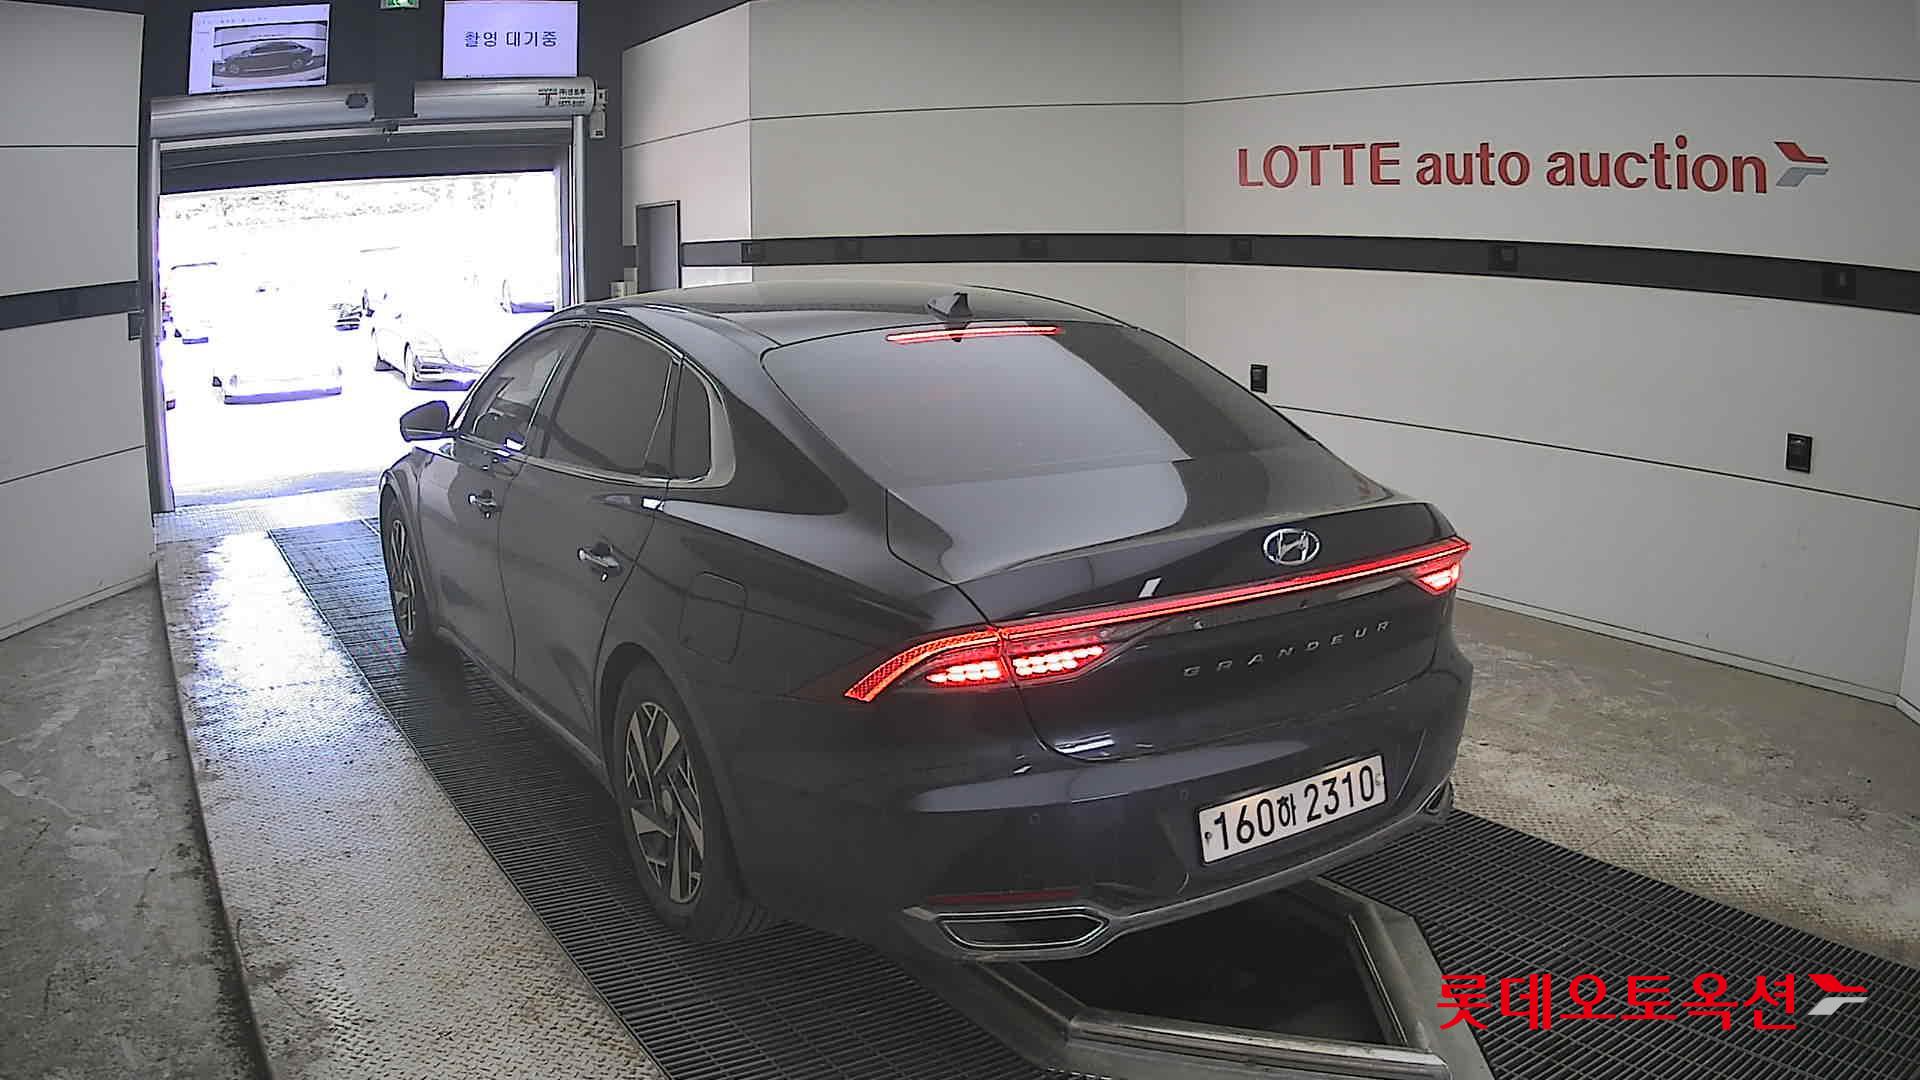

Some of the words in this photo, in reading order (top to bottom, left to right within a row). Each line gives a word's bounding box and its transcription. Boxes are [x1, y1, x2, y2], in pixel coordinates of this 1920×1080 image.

[465, 31, 497, 48] 촬영
[506, 31, 557, 48] 대기중
[1237, 142, 1400, 188] LOTTE
[1415, 142, 1531, 187] auto
[1546, 135, 1767, 194] auction
[1183, 620, 1394, 677] GRANDEUR
[1303, 764, 1375, 823] 2310
